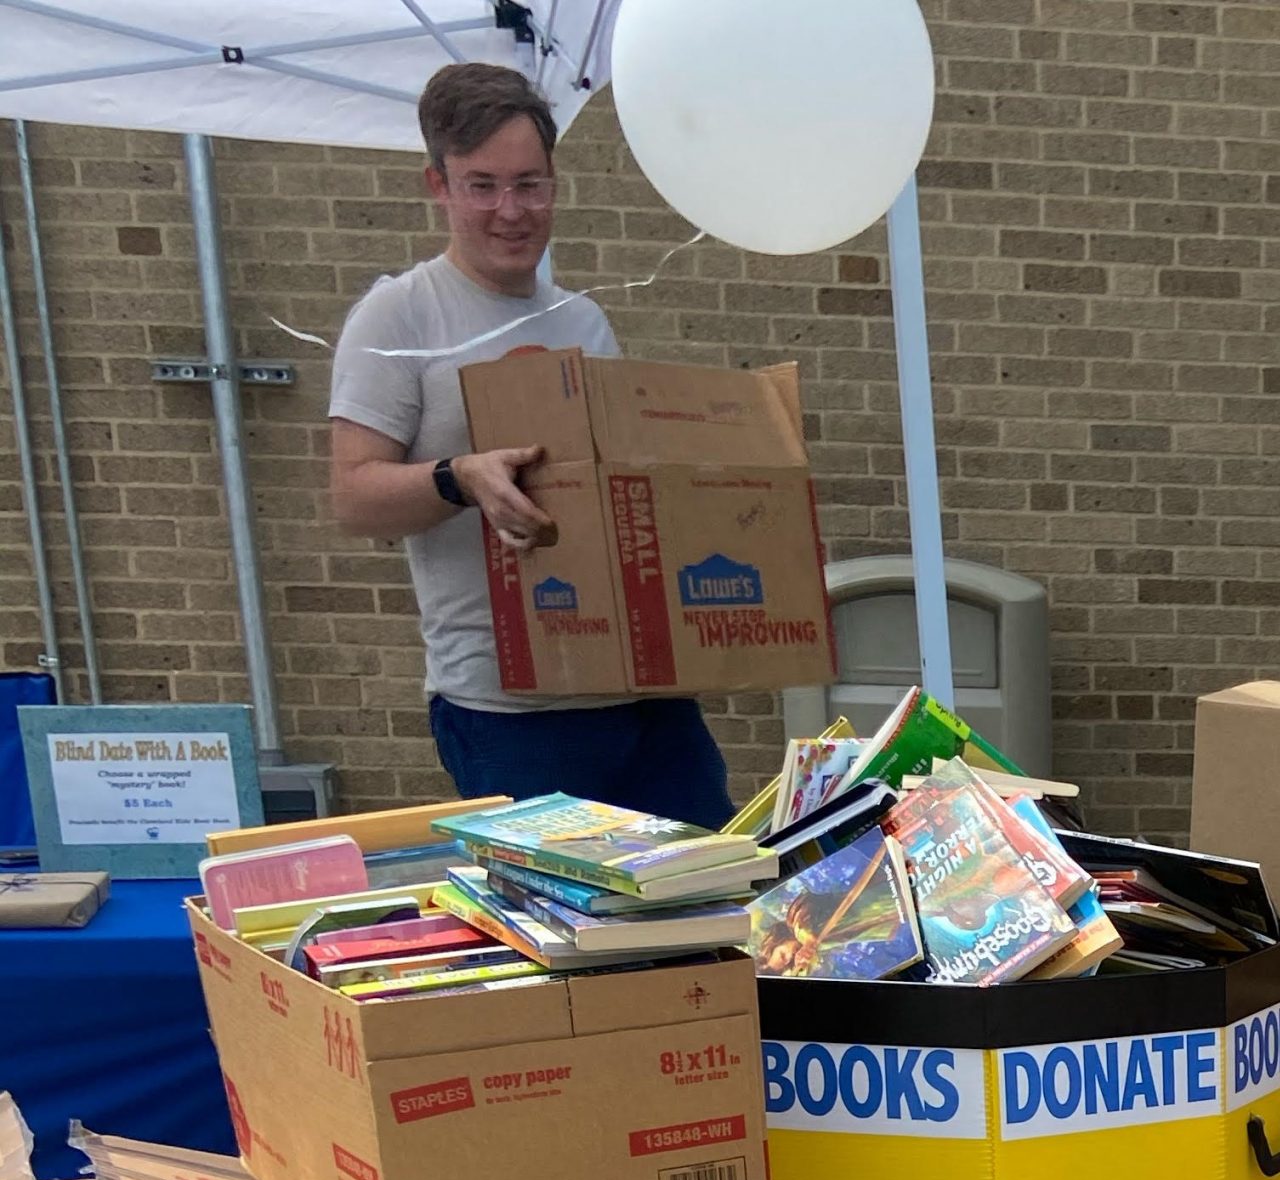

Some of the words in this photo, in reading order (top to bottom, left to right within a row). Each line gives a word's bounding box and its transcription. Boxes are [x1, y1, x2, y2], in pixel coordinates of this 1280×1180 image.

[628, 481, 659, 584] SMALL
[687, 574, 754, 599] LOWE'S
[699, 620, 818, 648] IMPROVING
[55, 741, 95, 761] Blind
[99, 741, 133, 761] Date
[135, 741, 172, 761] With
[175, 741, 188, 761] A
[190, 740, 228, 761] Book
[147, 770, 191, 780] wrapped
[144, 798, 173, 808] Each
[916, 853, 964, 901] NIGHT
[483, 1073, 521, 1090] copy
[525, 1066, 572, 1087] paper
[703, 1070, 729, 1084] size
[760, 1040, 961, 1123] BOOKS
[1002, 1032, 1217, 1124] DONATE
[399, 1087, 467, 1114] STAPLES
[644, 1122, 732, 1149] 135848-WH
